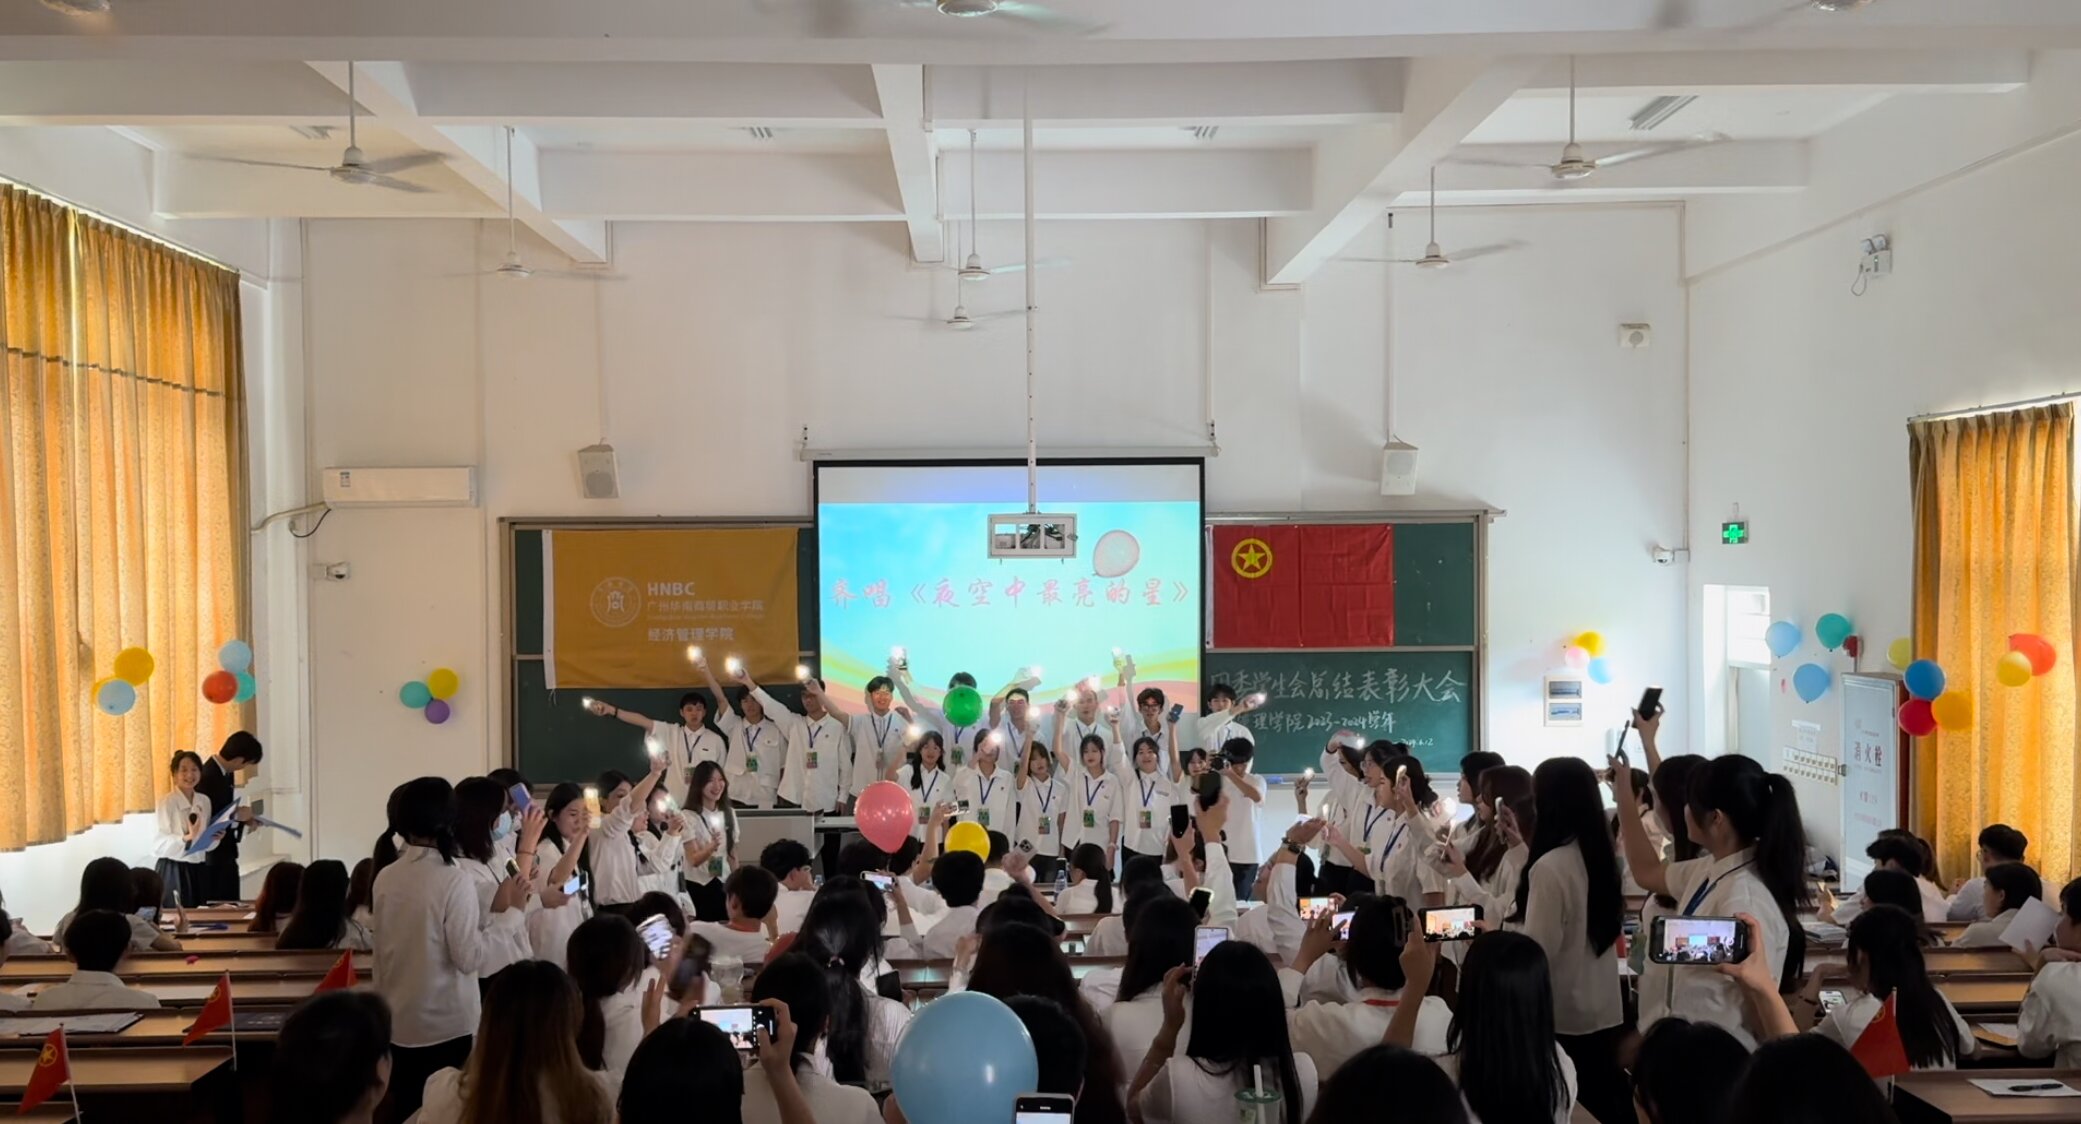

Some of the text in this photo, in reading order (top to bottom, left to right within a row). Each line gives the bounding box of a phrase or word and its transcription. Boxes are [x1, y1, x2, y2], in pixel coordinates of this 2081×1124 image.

[647, 582, 695, 596] HNBC
[648, 628, 734, 641] 经济管理学院
[1854, 741, 1882, 767] 消火栓
